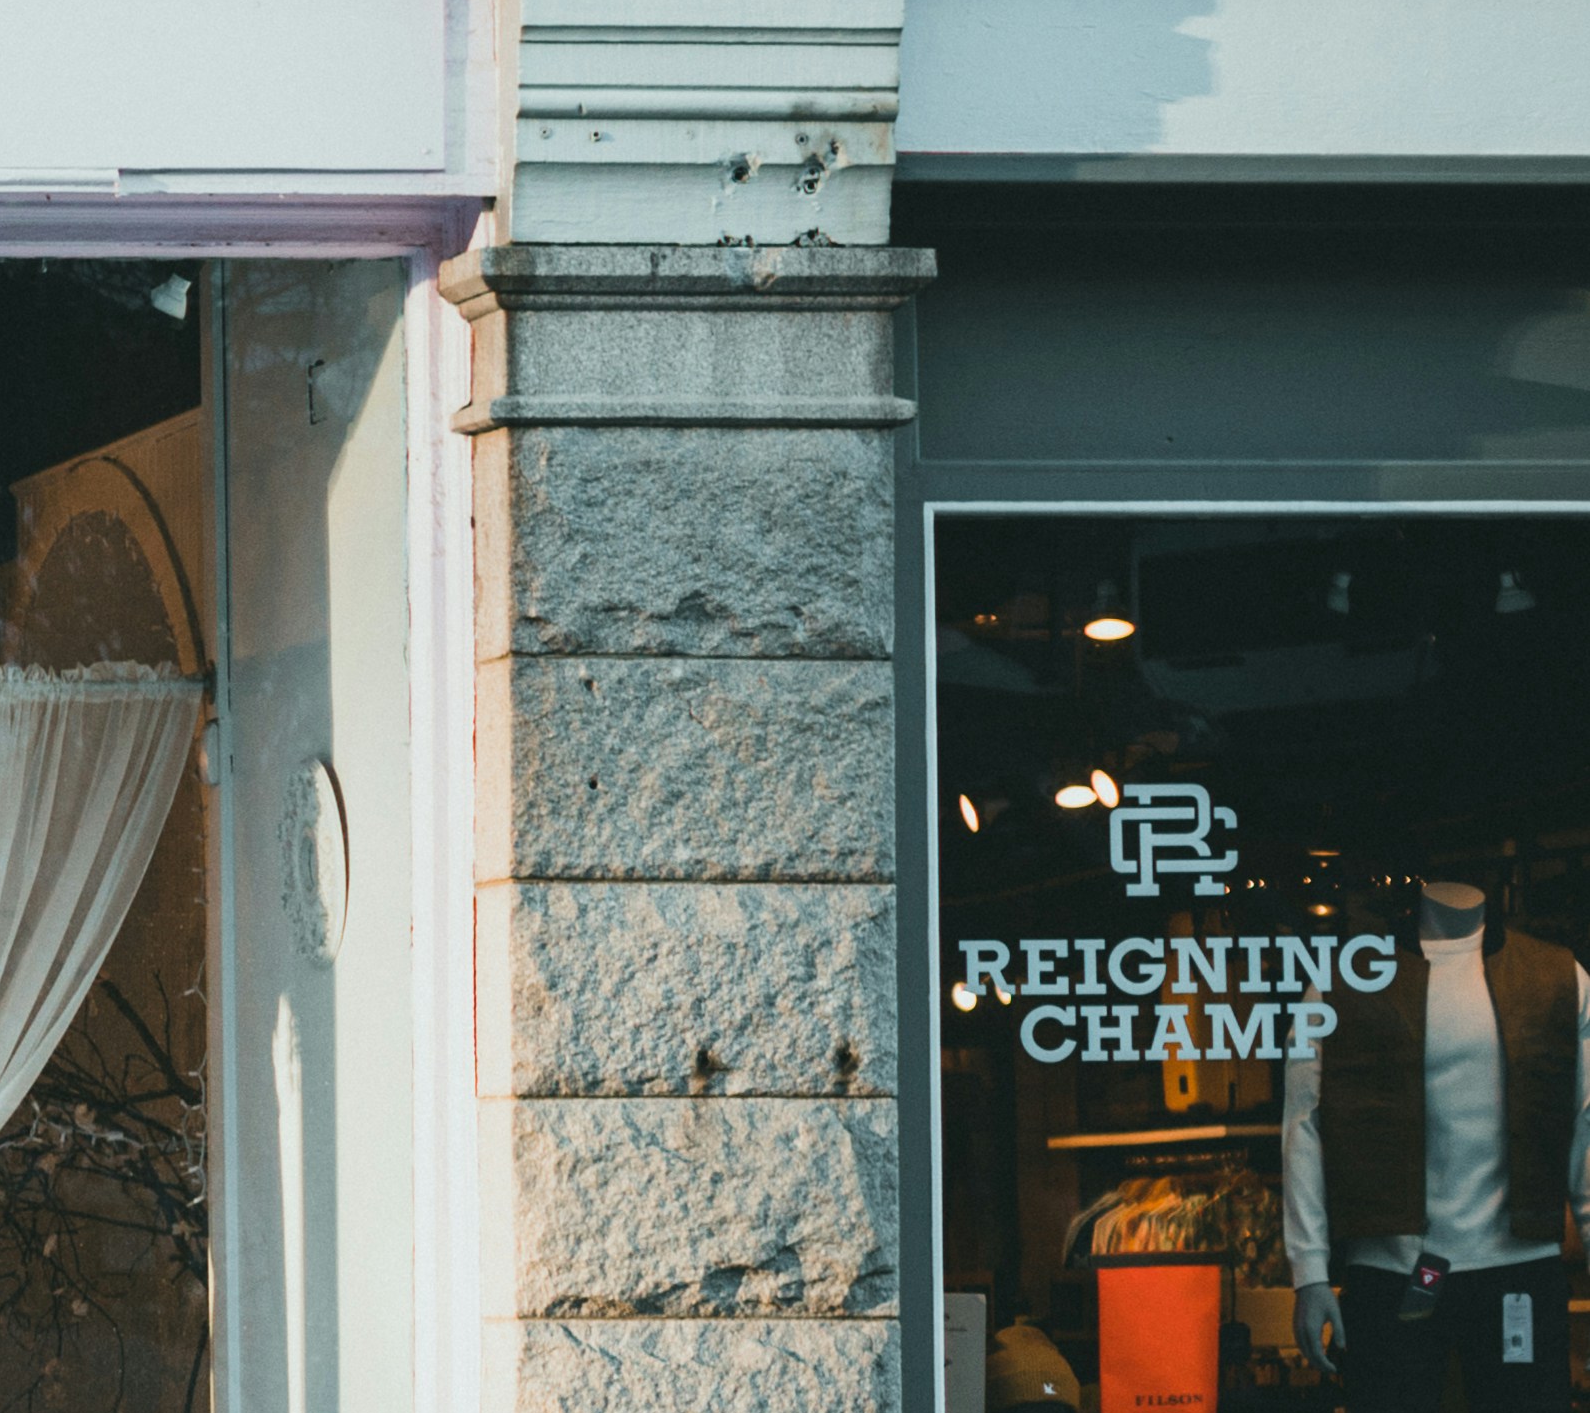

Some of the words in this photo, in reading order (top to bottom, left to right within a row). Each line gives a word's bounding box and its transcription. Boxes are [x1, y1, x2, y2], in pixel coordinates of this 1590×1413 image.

[958, 934, 1398, 996] REIGNING
[1019, 1002, 1338, 1064] CHAMP
[1135, 1393, 1203, 1407] FILSON
